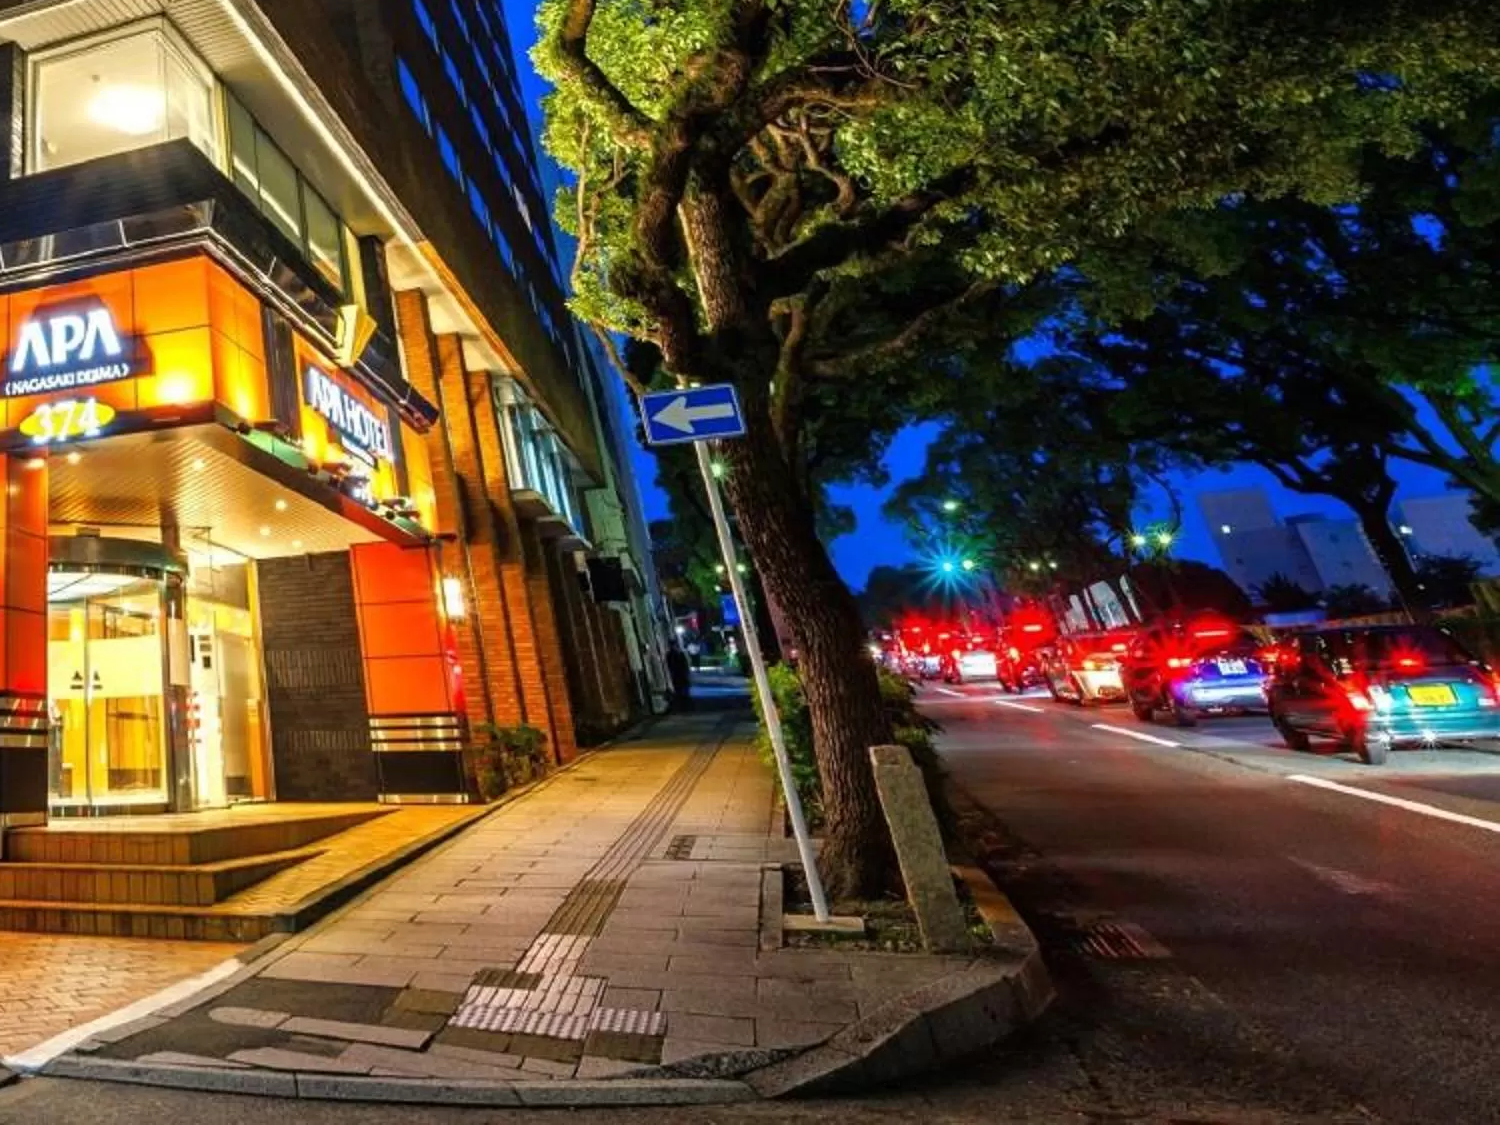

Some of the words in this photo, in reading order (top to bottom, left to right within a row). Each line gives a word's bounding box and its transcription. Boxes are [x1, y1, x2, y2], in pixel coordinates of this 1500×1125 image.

[11, 307, 122, 372] APA
[32, 396, 101, 445] 374
[308, 366, 345, 428] APA
[344, 397, 389, 455] HOTEL
